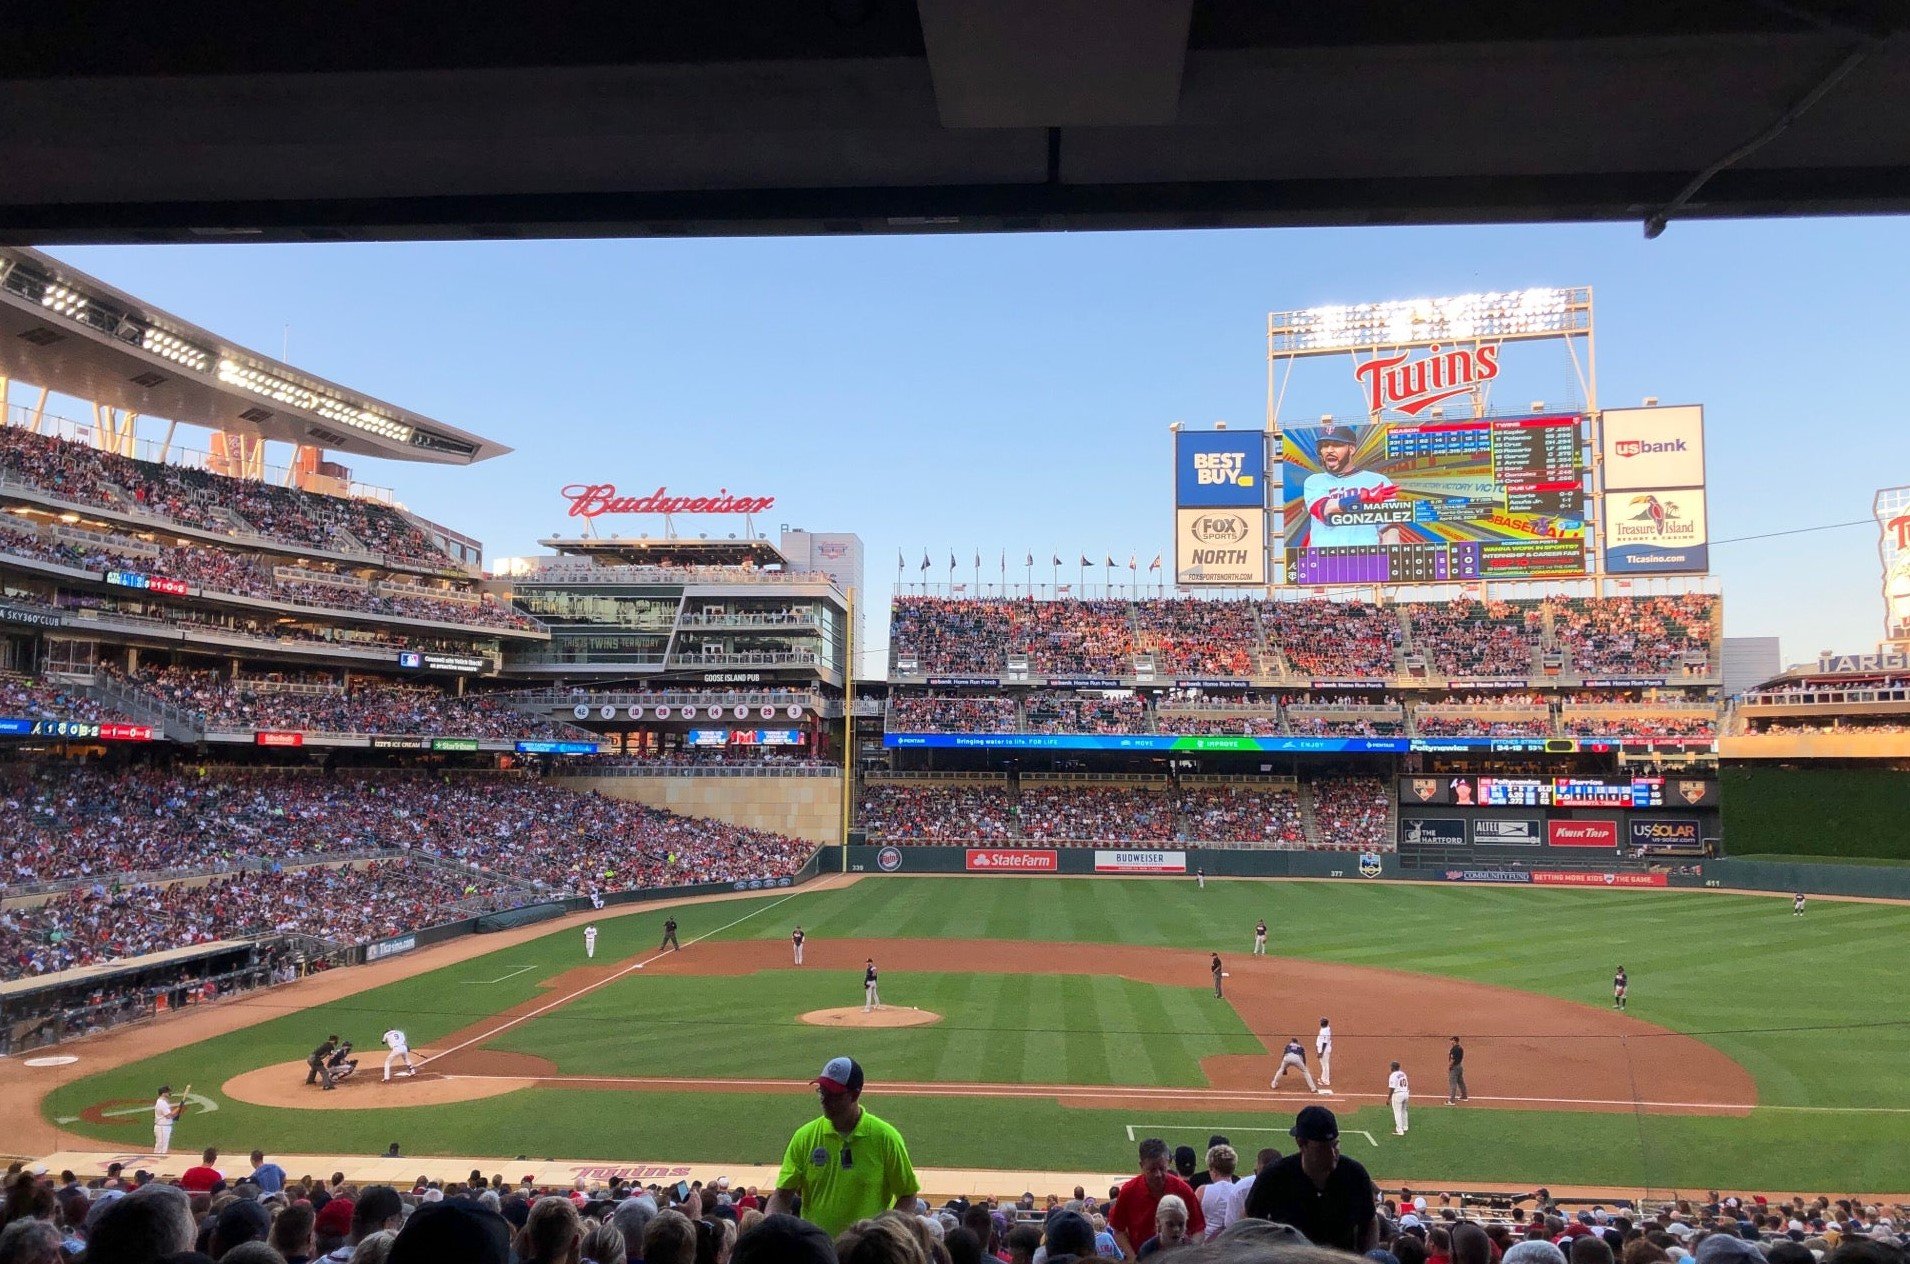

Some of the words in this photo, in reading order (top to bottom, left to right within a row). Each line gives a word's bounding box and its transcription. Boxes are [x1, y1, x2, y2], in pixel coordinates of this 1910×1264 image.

[1354, 343, 1499, 416] Twins
[1194, 453, 1245, 469] BEST
[1198, 469, 1241, 484] BUY
[561, 484, 775, 517] Budweiser
[1364, 502, 1412, 510] MARWIN
[1331, 512, 1412, 526] GONZALEZ
[1203, 519, 1236, 533] FOX
[1616, 522, 1656, 536] Treasure
[1665, 520, 1694, 534] Island
[1192, 549, 1248, 564] NORTH
[40, 616, 59, 626] CLUB
[590, 638, 618, 650] TWINS
[622, 638, 659, 648] TERRITORY
[704, 674, 724, 682] GOOSE
[725, 674, 746, 682] ISLAND
[747, 674, 760, 682] PUB
[576, 708, 586, 716] 42
[632, 708, 640, 716] 10
[763, 708, 772, 716] 29
[956, 738, 984, 746] Bringing
[1476, 822, 1499, 832] ALTEC
[1556, 828, 1585, 838] KWIK
[1586, 828, 1609, 838] TRIP
[1116, 854, 1164, 862] BUDWEISER
[1464, 872, 1508, 880] COMMUNITY
[1509, 872, 1530, 880] FUND
[569, 1166, 692, 1180] Twins
